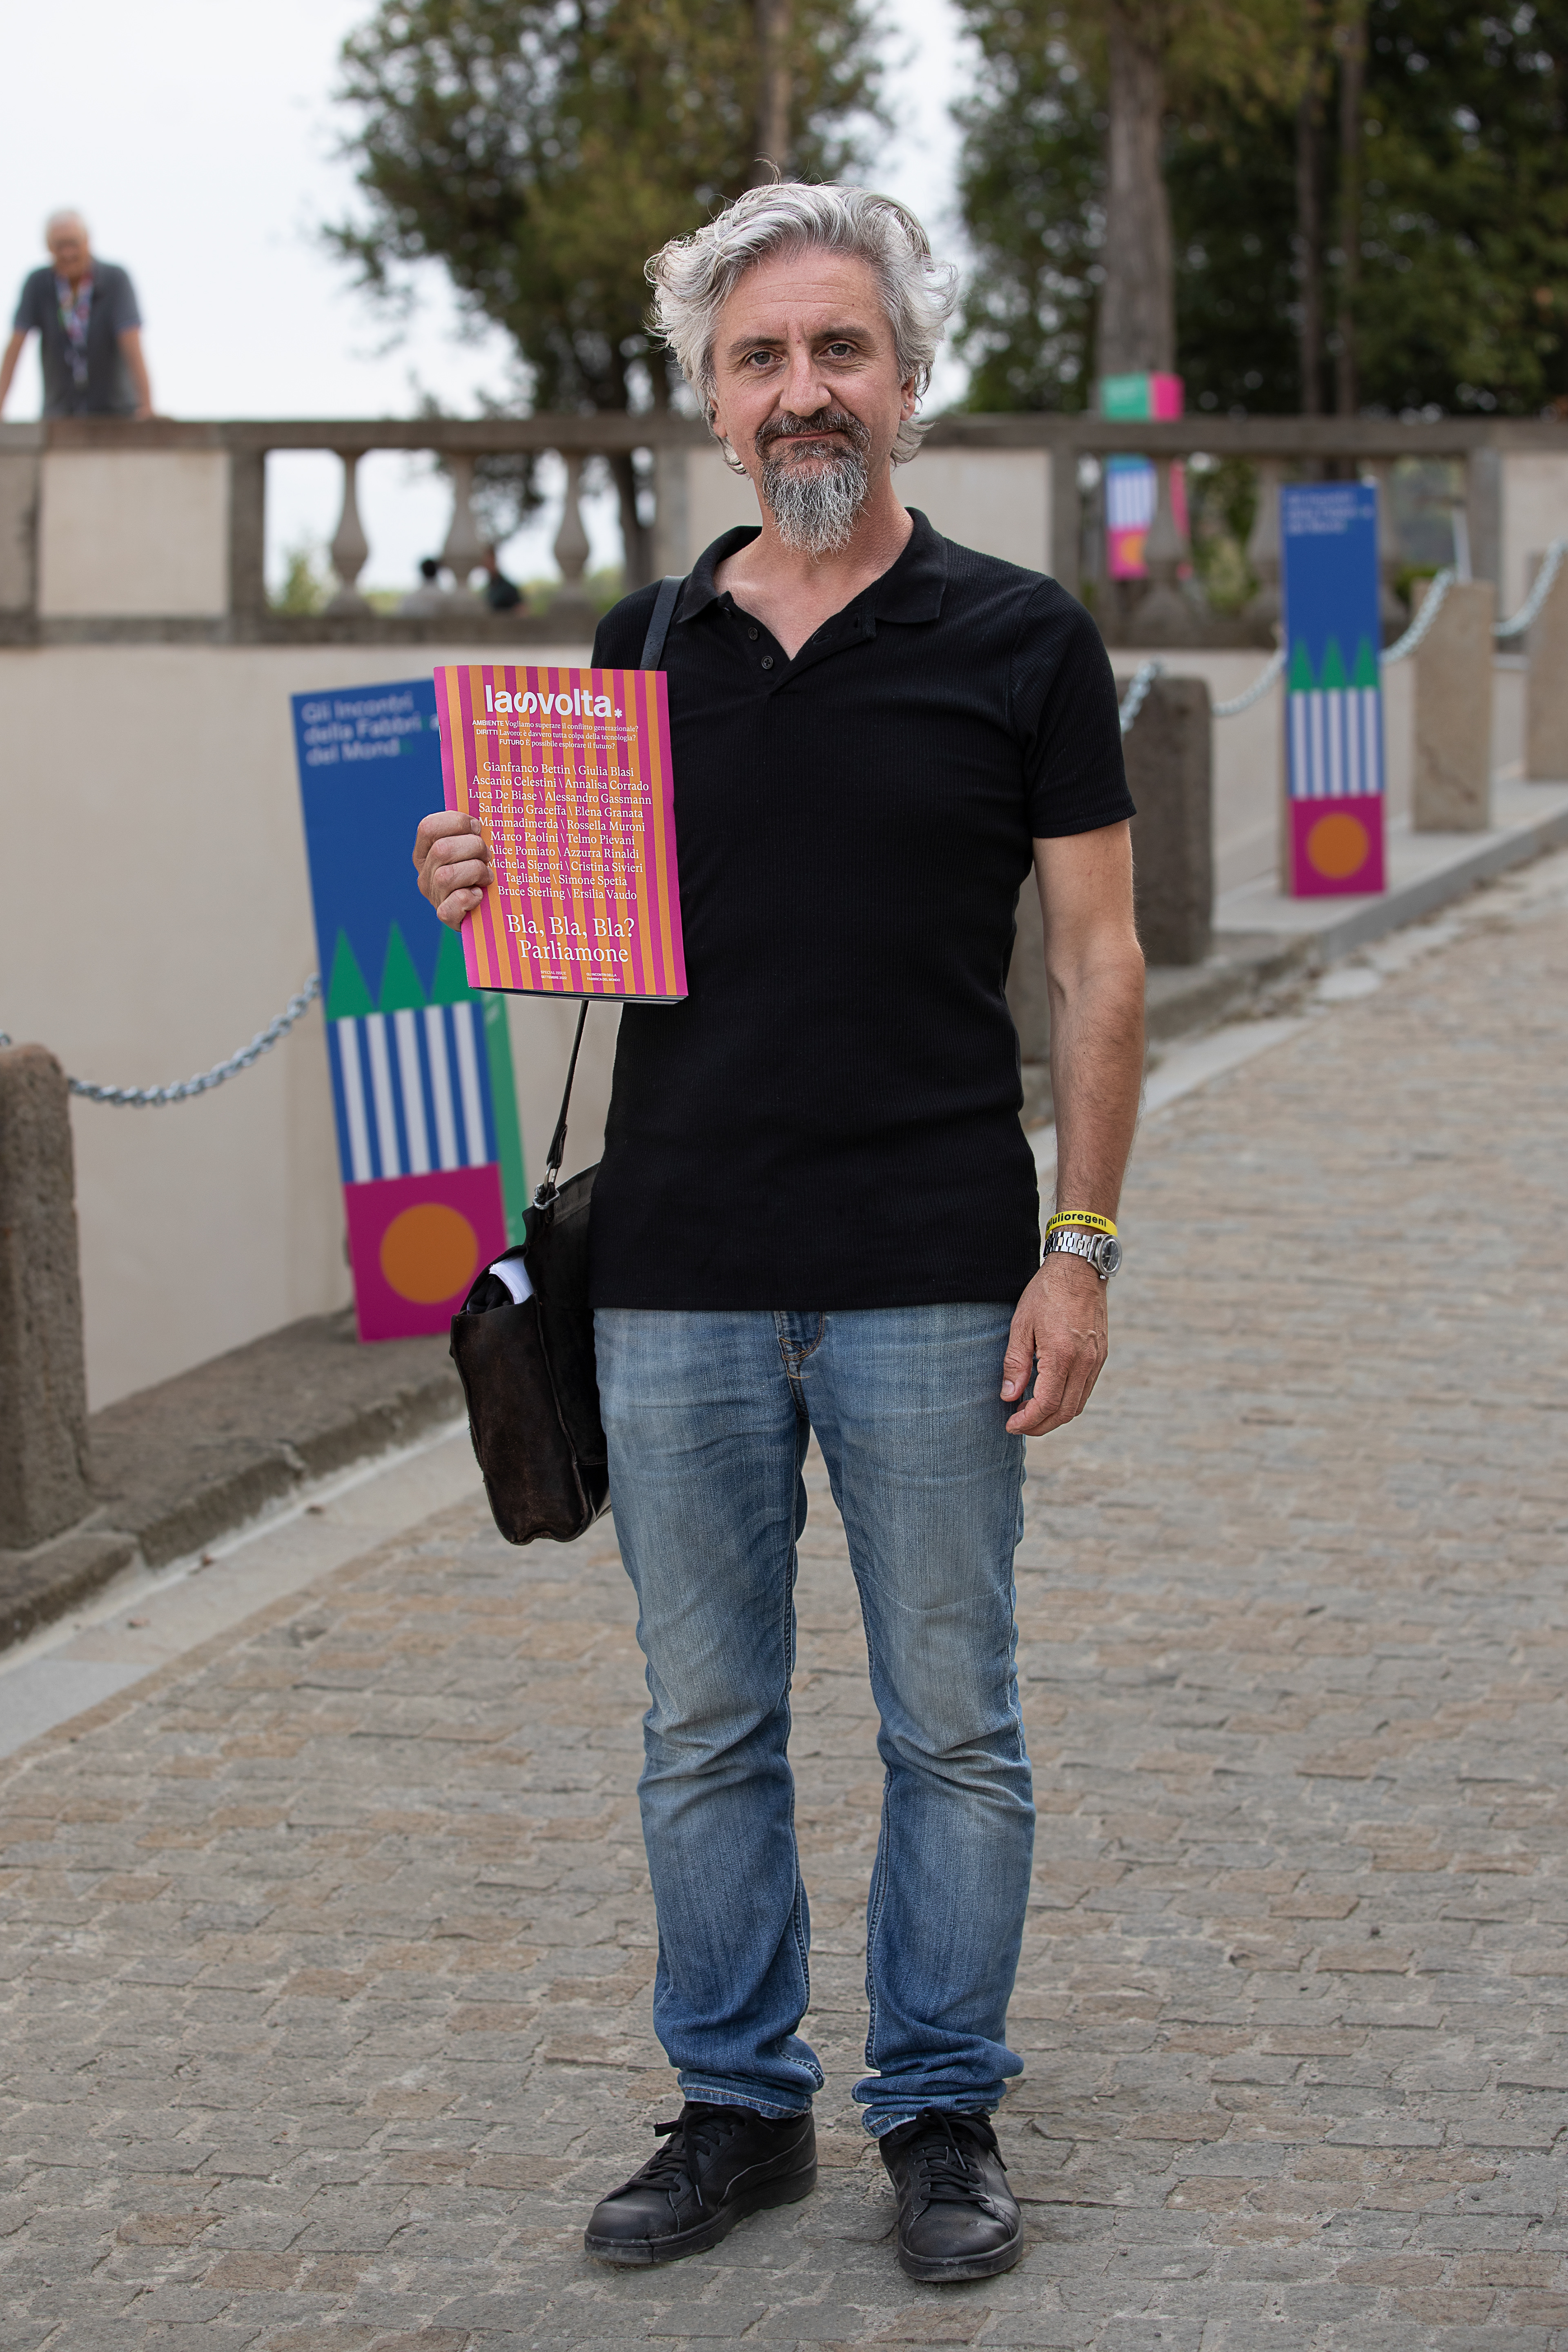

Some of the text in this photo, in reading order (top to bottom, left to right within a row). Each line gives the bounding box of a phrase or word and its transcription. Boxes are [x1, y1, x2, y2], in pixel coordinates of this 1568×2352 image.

[504, 720, 535, 728] Vogliamo
[568, 732, 585, 740] colpa
[601, 734, 636, 742] tecnologia?
[483, 761, 539, 773] Gianfranco
[541, 764, 571, 774] Bettin
[578, 765, 608, 776] Giulia
[610, 766, 634, 777] Blasi
[472, 775, 512, 786] Ascanio
[514, 776, 557, 787] Celestini
[565, 778, 608, 789] Annalisa
[610, 780, 649, 791] Corrado
[468, 788, 493, 799] Luca
[495, 789, 509, 800] De
[511, 790, 537, 801] Biase
[545, 791, 599, 803] Alessandro
[601, 793, 652, 804] Gassmann
[479, 802, 523, 814] Sandrino
[526, 804, 567, 815] Graceffa
[574, 806, 603, 817] Elena
[604, 807, 644, 818] Granata
[478, 817, 559, 829] Mammadimerda
[566, 819, 607, 831] Rossella
[609, 821, 646, 832] Muroni
[490, 831, 522, 842] Marco
[524, 832, 559, 842] Paolini
[566, 833, 597, 844] Telmo
[599, 834, 635, 845] Pievani
[489, 844, 513, 855] Alice
[514, 845, 555, 856] Pomiato
[563, 847, 602, 858] Azzurra
[604, 849, 639, 859] Rinaldi
[486, 858, 526, 870] Michela
[528, 860, 564, 872] Signori
[571, 861, 610, 872] Cristina
[612, 862, 643, 873] Sivieri
[503, 872, 551, 885] Tagliabue
[559, 874, 595, 885] Simone
[597, 875, 628, 888] Spetia
[497, 885, 526, 896] Bruce
[527, 886, 566, 900] Sterling
[572, 888, 605, 899] Ersilia
[606, 889, 637, 900] Vaudo
[506, 914, 635, 939] Bla, Bla, Bla?
[518, 940, 629, 962] Parliamone
